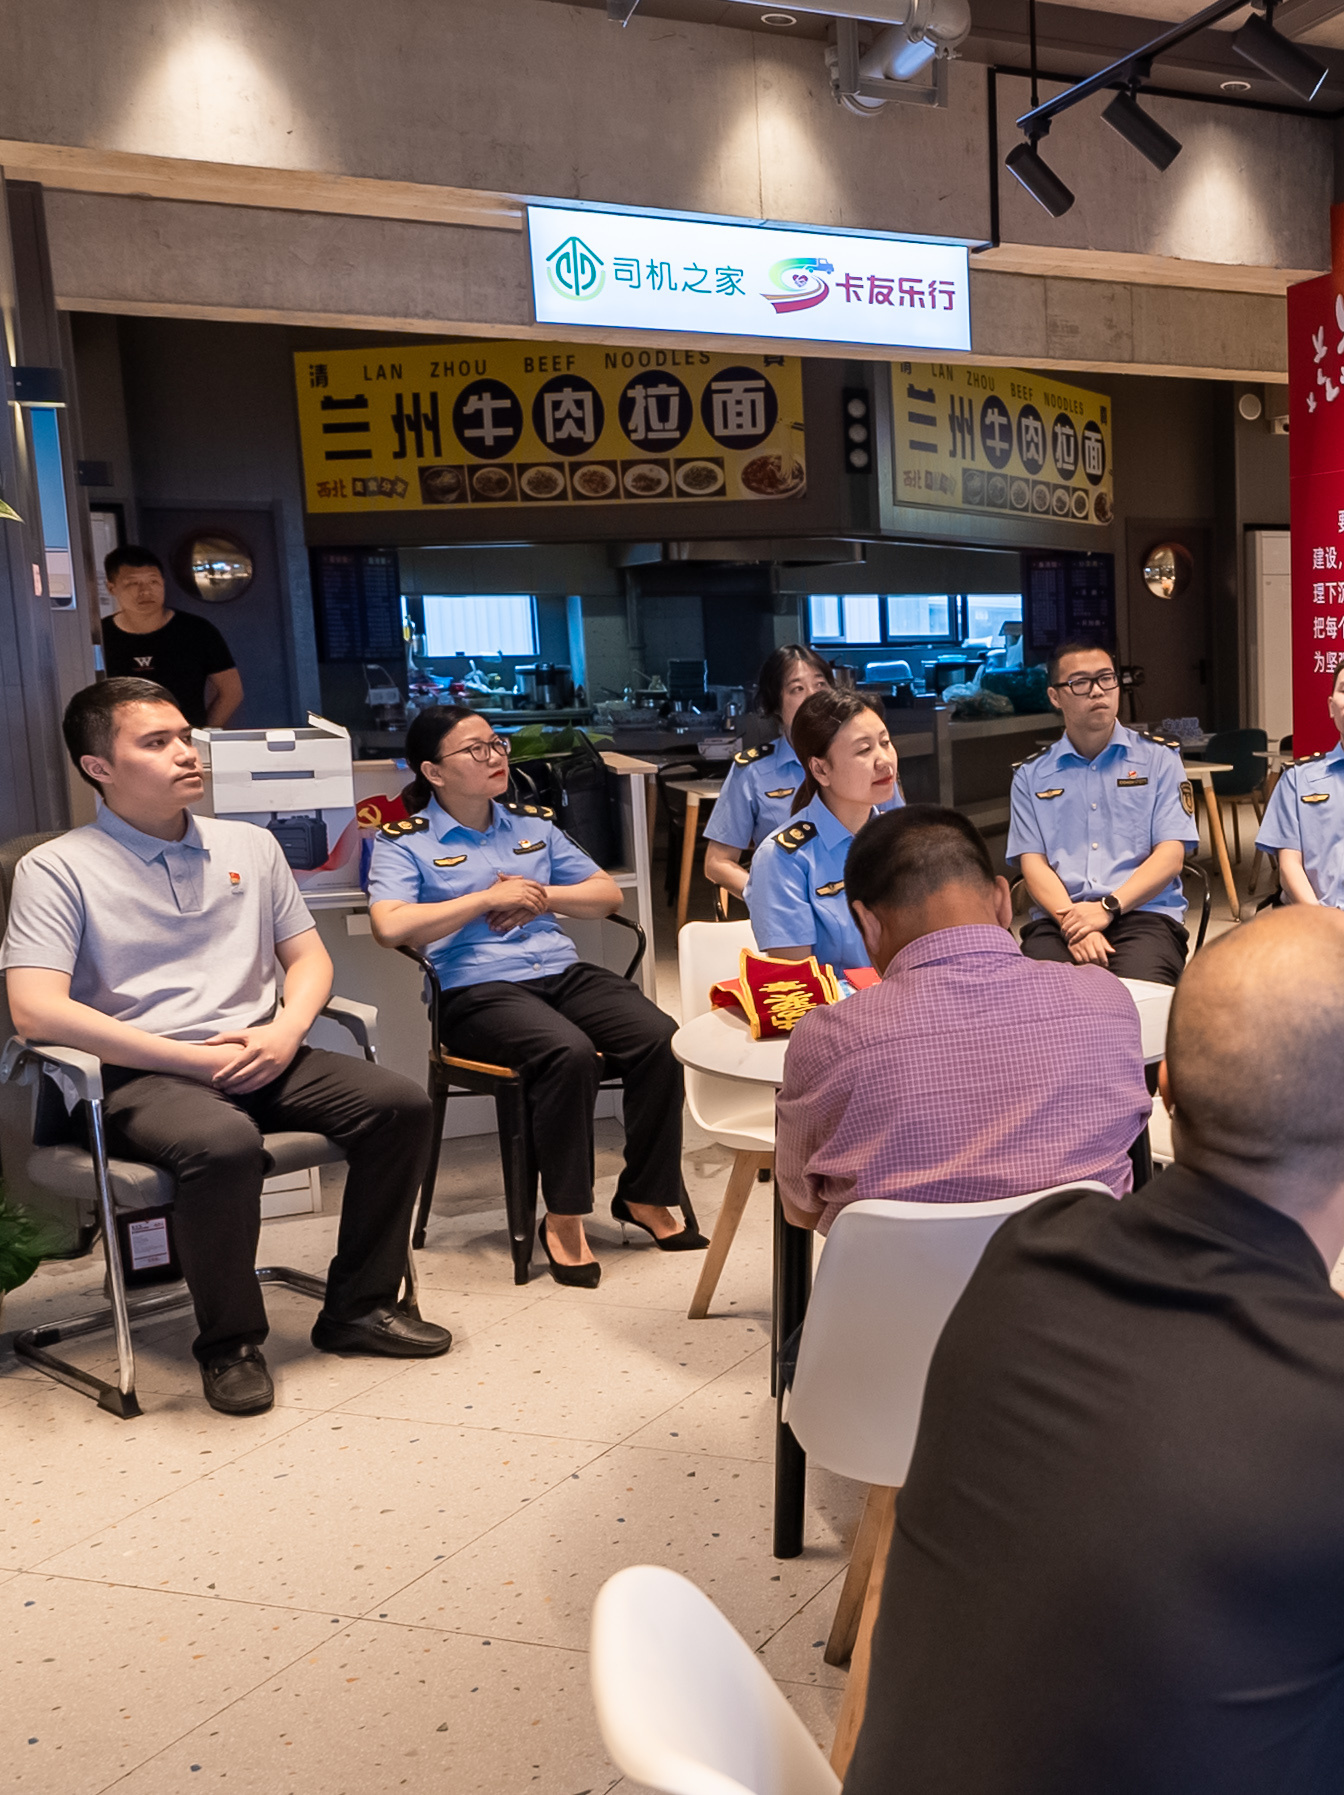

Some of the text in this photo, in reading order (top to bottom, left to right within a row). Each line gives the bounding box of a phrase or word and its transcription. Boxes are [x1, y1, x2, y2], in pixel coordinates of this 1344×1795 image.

[613, 257, 956, 311] 司机之家 卡友乐行
[364, 350, 710, 381] LAN ZHOU BEEF NOODLES
[931, 364, 1084, 416] LAN ZHOU BEEF NOODLES
[321, 380, 766, 461] 兰州牛肉拉面
[907, 383, 1103, 477] 兰州牛肉拉面
